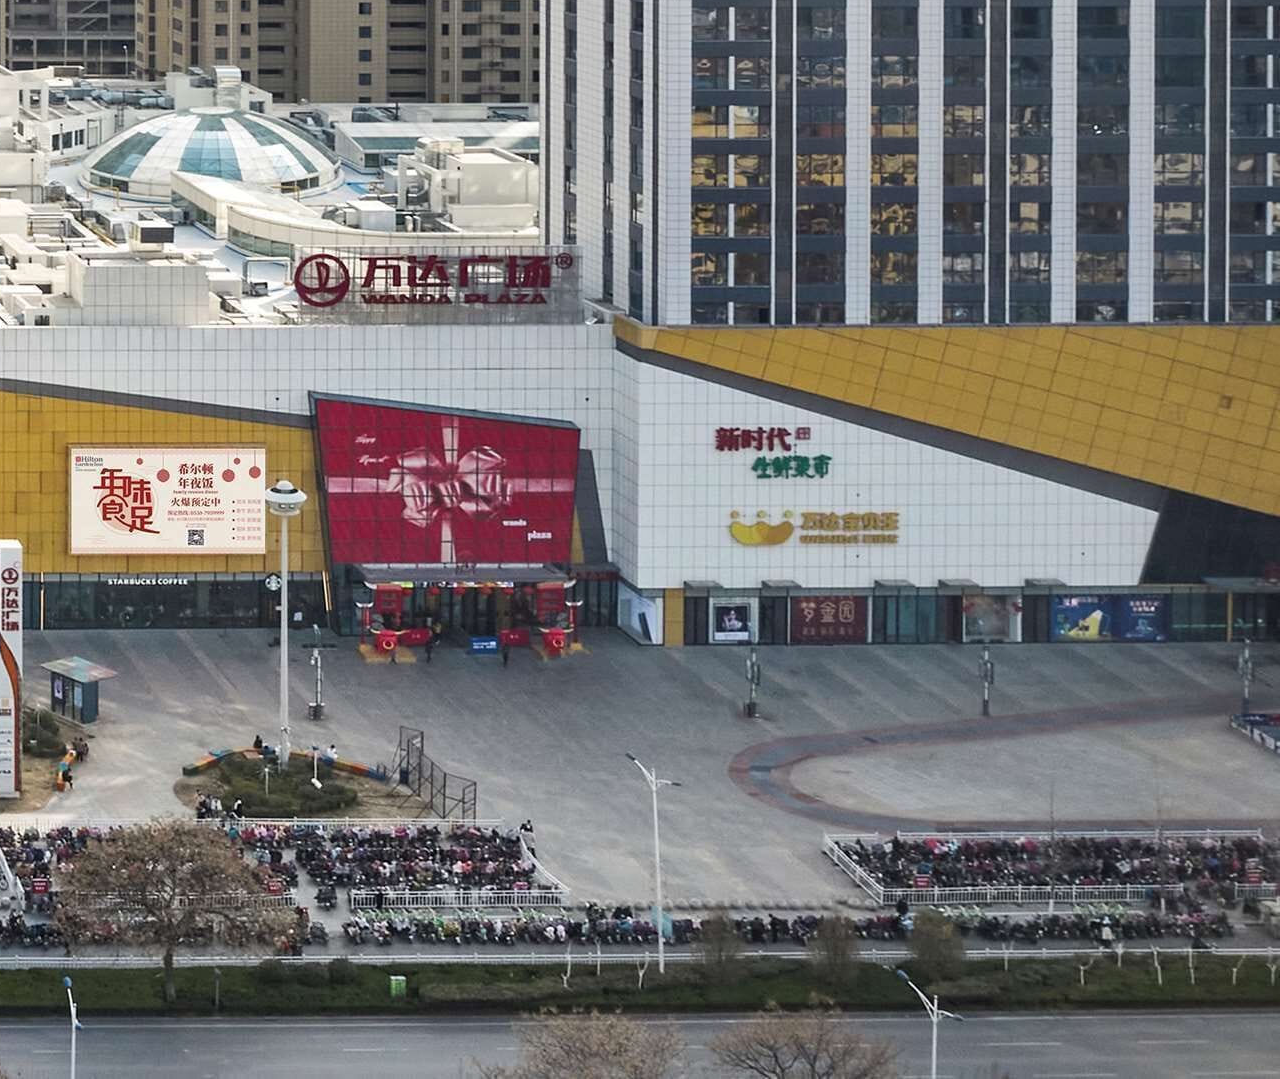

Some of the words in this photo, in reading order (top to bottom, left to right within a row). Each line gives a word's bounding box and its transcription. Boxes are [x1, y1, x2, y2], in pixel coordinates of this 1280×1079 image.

[360, 254, 551, 288] 万达广场
[361, 294, 453, 305] WANDA
[464, 293, 548, 305] PLAZA
[715, 426, 792, 452] 新时代
[179, 463, 214, 475] 希尔顿
[178, 477, 214, 489] 年夜饭
[171, 497, 221, 507] 火爆预定中
[107, 578, 157, 586] STARBUCKS
